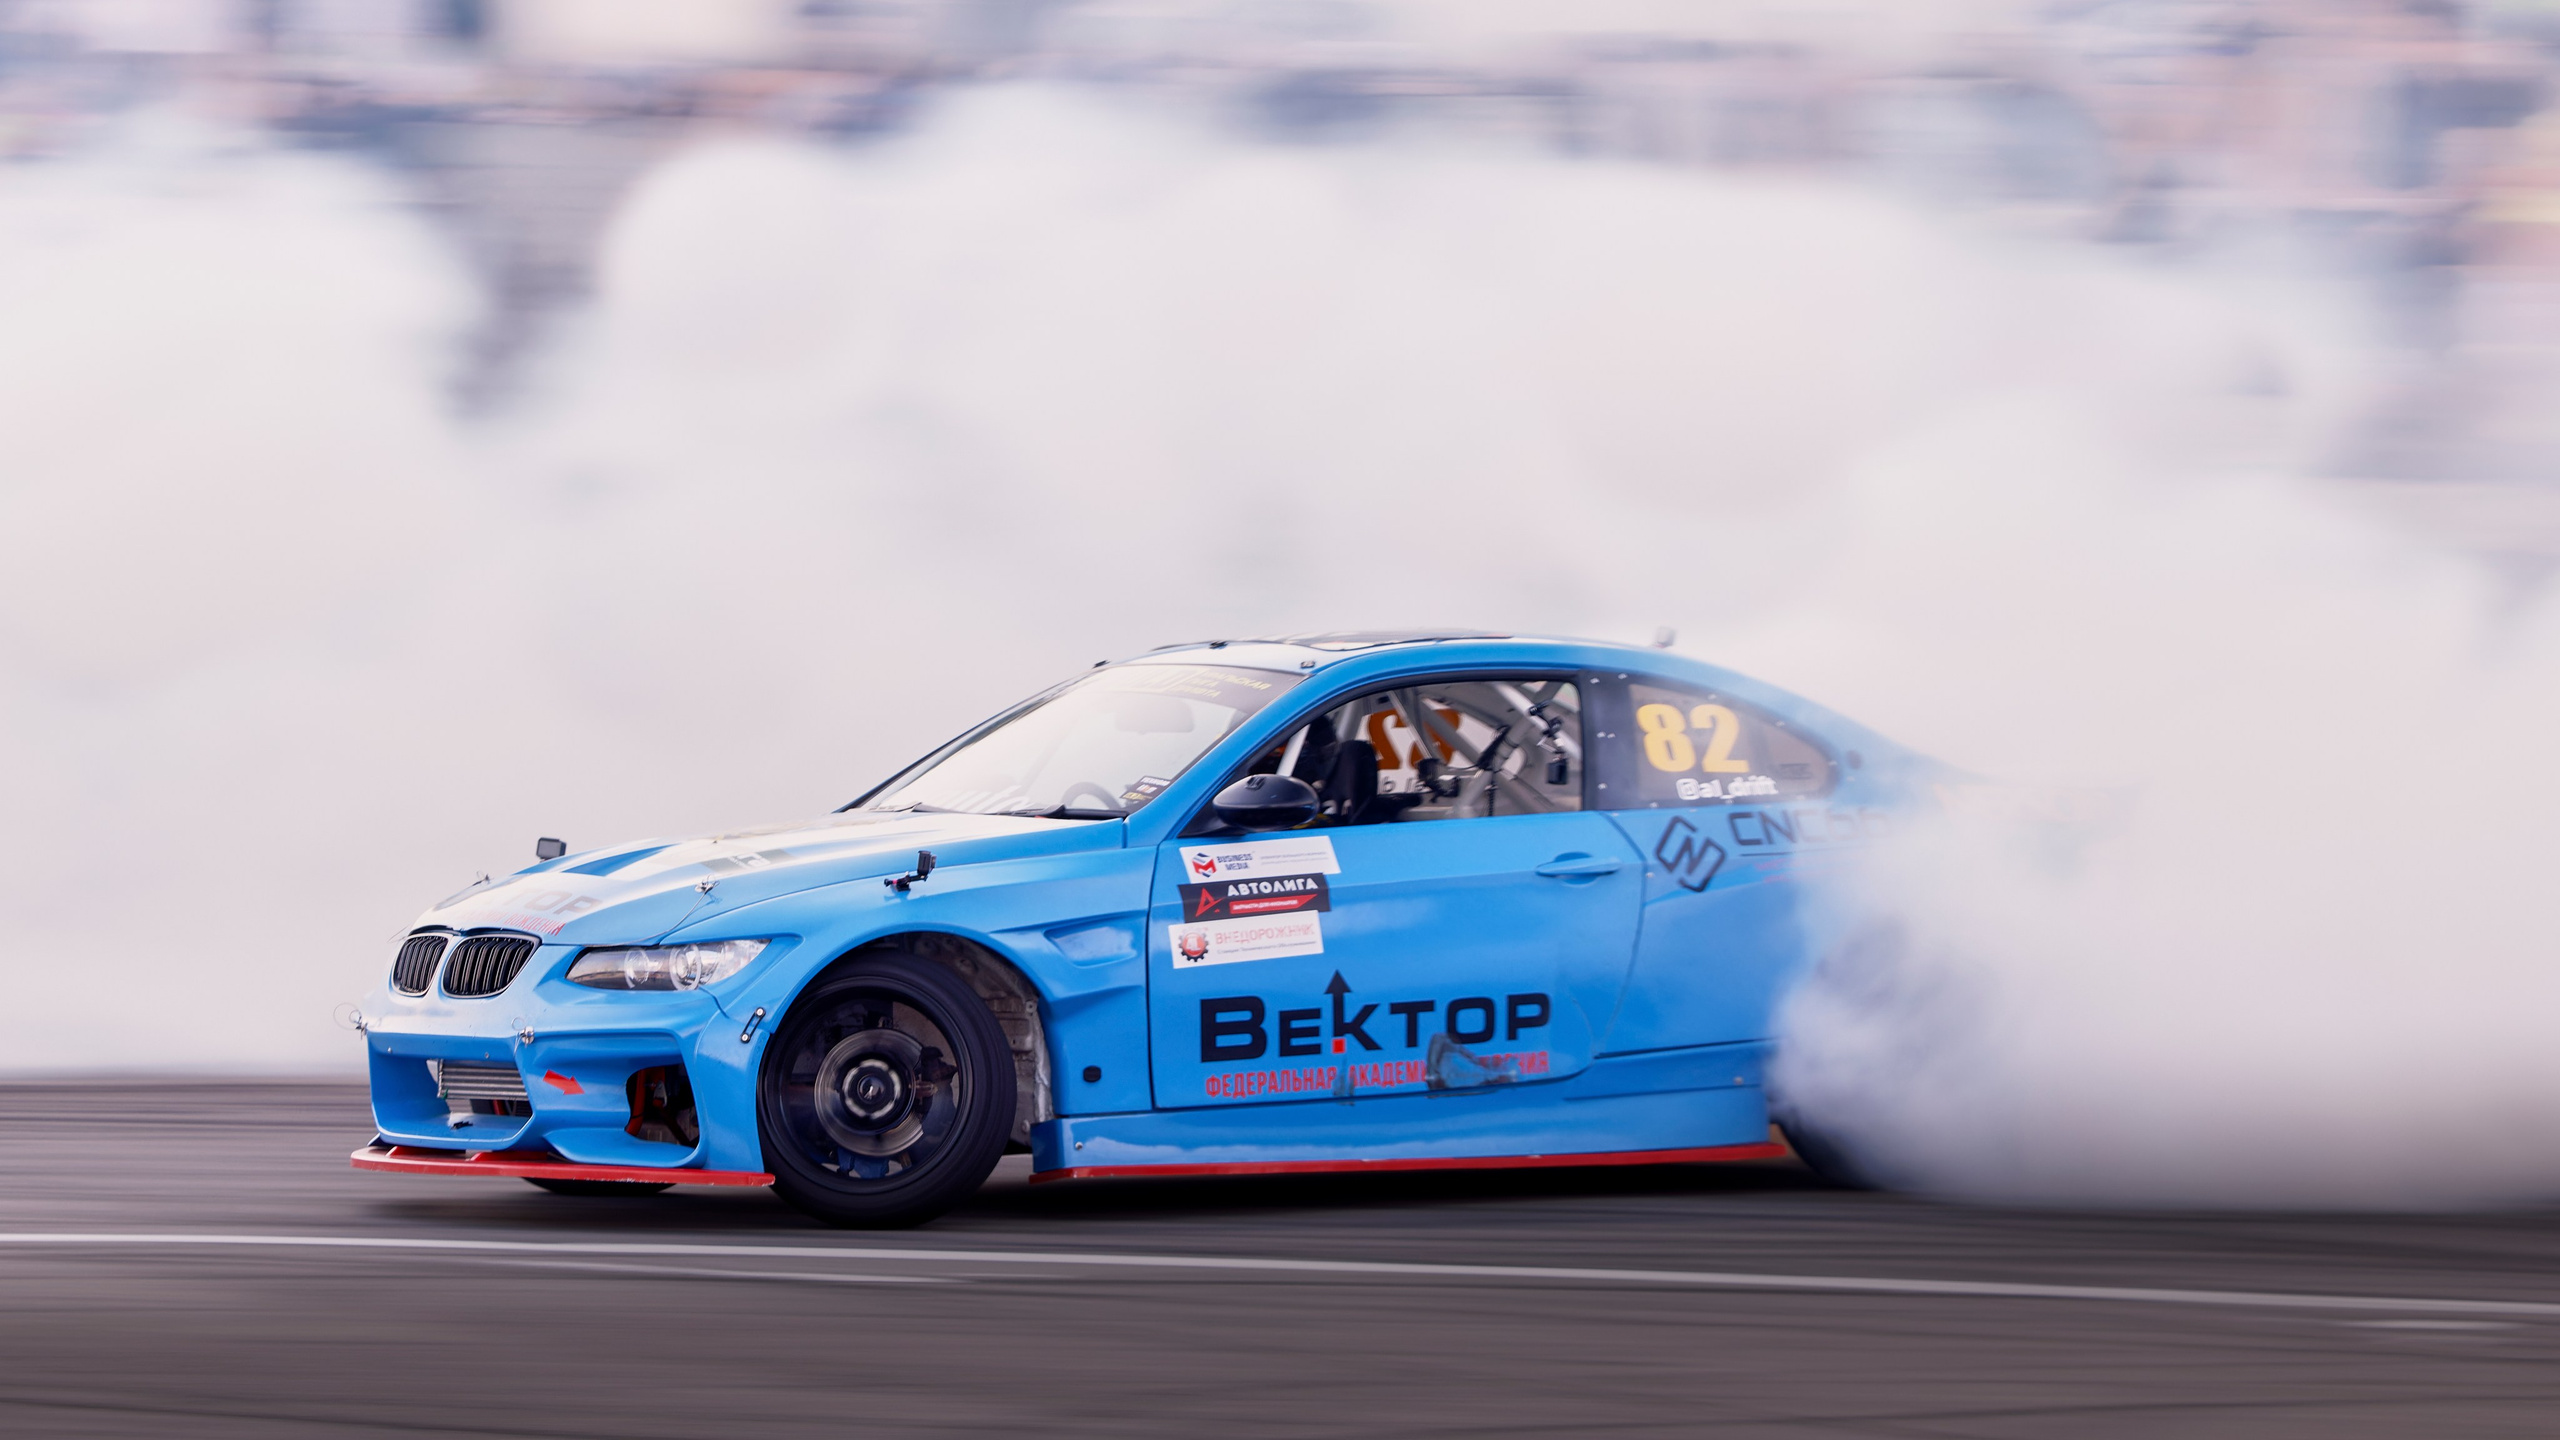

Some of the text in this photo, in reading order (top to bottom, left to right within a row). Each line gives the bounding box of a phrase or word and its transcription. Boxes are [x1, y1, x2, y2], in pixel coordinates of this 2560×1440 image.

[1636, 703, 1750, 773] 82
[1676, 775, 1779, 800] @al_drift
[1216, 853, 1254, 864] BUSINESS
[1225, 862, 1250, 871] MEDIA
[1227, 877, 1319, 897] АВТОЛИГА
[1215, 923, 1316, 944] ВНЕДОРОЖНИК
[1200, 989, 1550, 1062] ВЕКТОР
[1348, 1060, 1428, 1087] АКАДЕМИ
